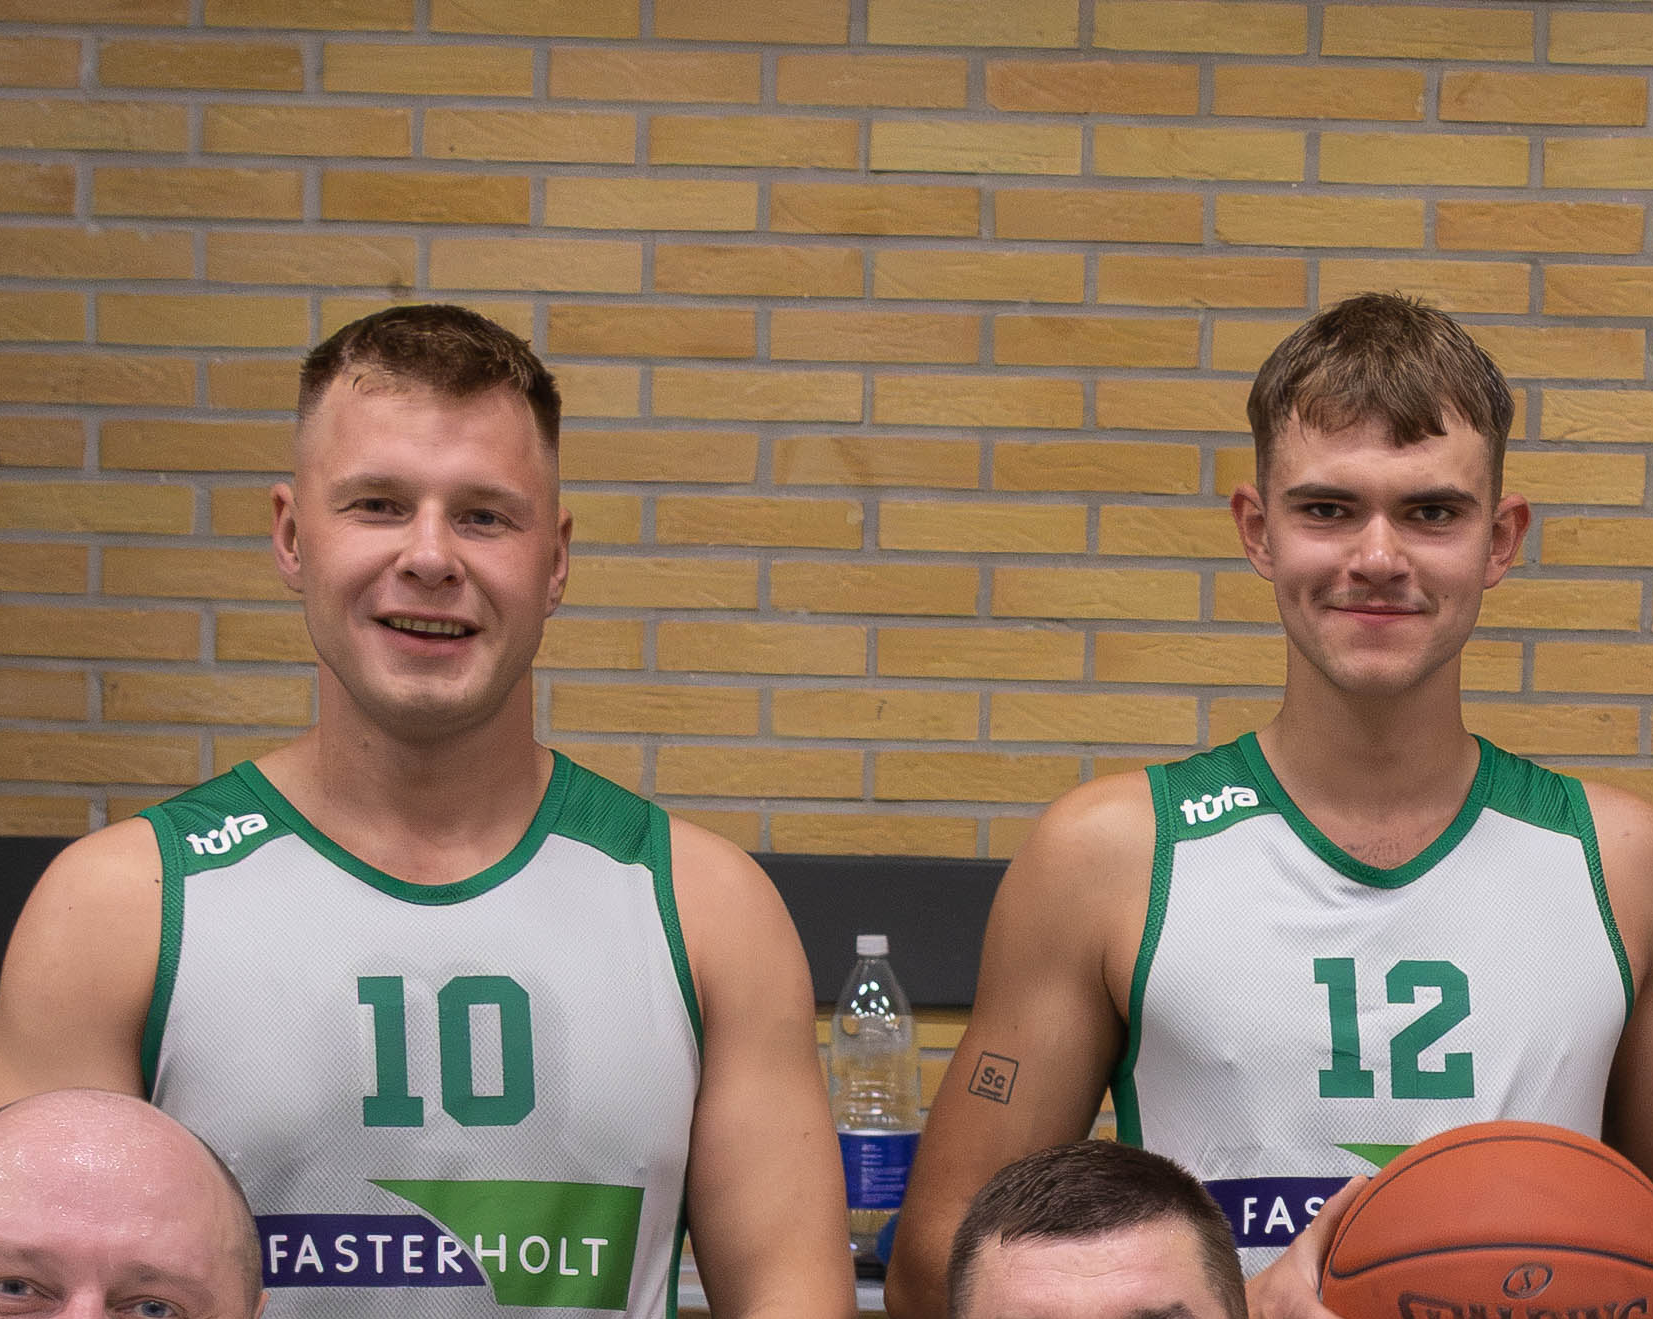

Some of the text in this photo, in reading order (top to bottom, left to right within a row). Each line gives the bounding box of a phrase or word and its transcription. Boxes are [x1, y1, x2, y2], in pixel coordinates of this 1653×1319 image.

[358, 975, 536, 1128] 10
[1313, 957, 1475, 1099] 12
[270, 1233, 610, 1279] FASTERHOLT
